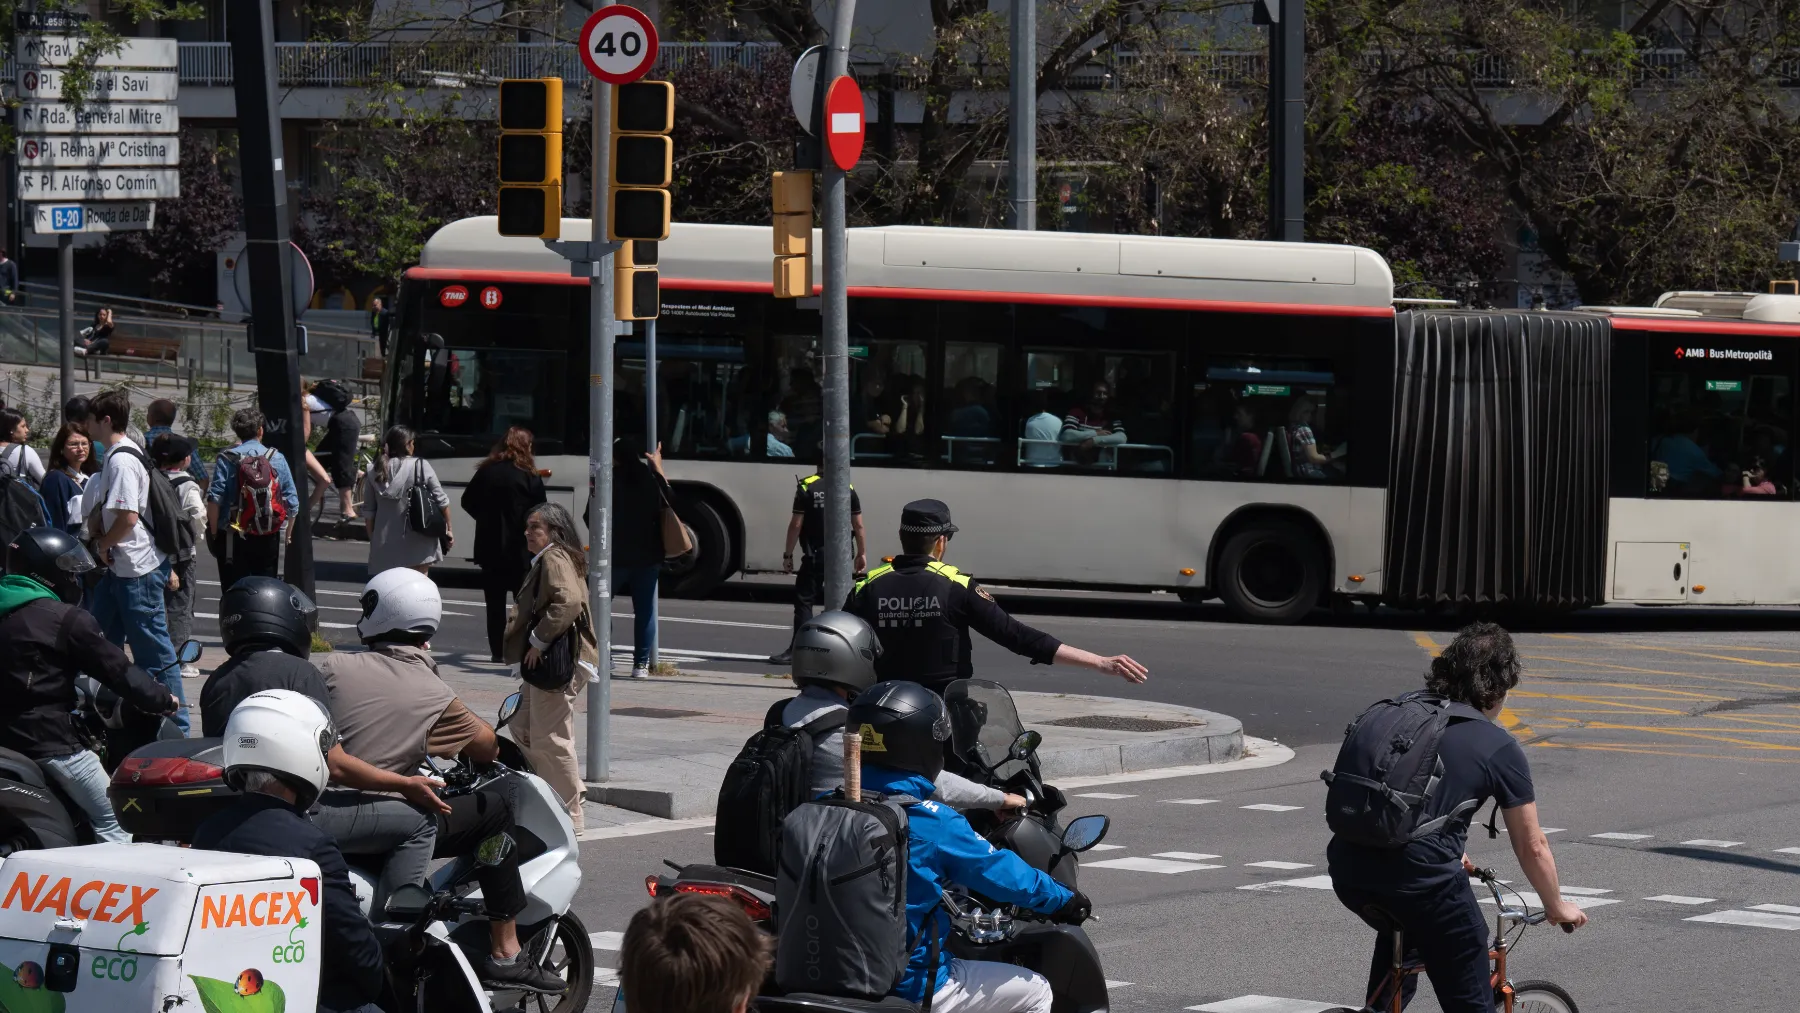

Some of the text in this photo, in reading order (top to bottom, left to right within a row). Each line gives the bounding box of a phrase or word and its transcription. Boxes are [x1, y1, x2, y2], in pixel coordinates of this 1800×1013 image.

[40, 41, 72, 57] Trav.
[595, 31, 641, 57] 40
[41, 74, 56, 90] Pl.
[107, 76, 117, 92] el
[122, 76, 149, 92] Savi
[41, 108, 162, 125] Rda. General Mitre
[41, 141, 166, 157] Pl. Reina Mª Cristina
[41, 174, 157, 191] Pl. Alfonso Comín
[55, 206, 151, 227] B-20 Ronda de Dalt
[1685, 348, 1773, 361] AMB Bus Metropolità
[878, 596, 941, 610] POLICIA
[2, 871, 160, 926] NACEX
[201, 891, 307, 929] NACEX
[272, 943, 305, 963] eco
[91, 953, 138, 982] eco
